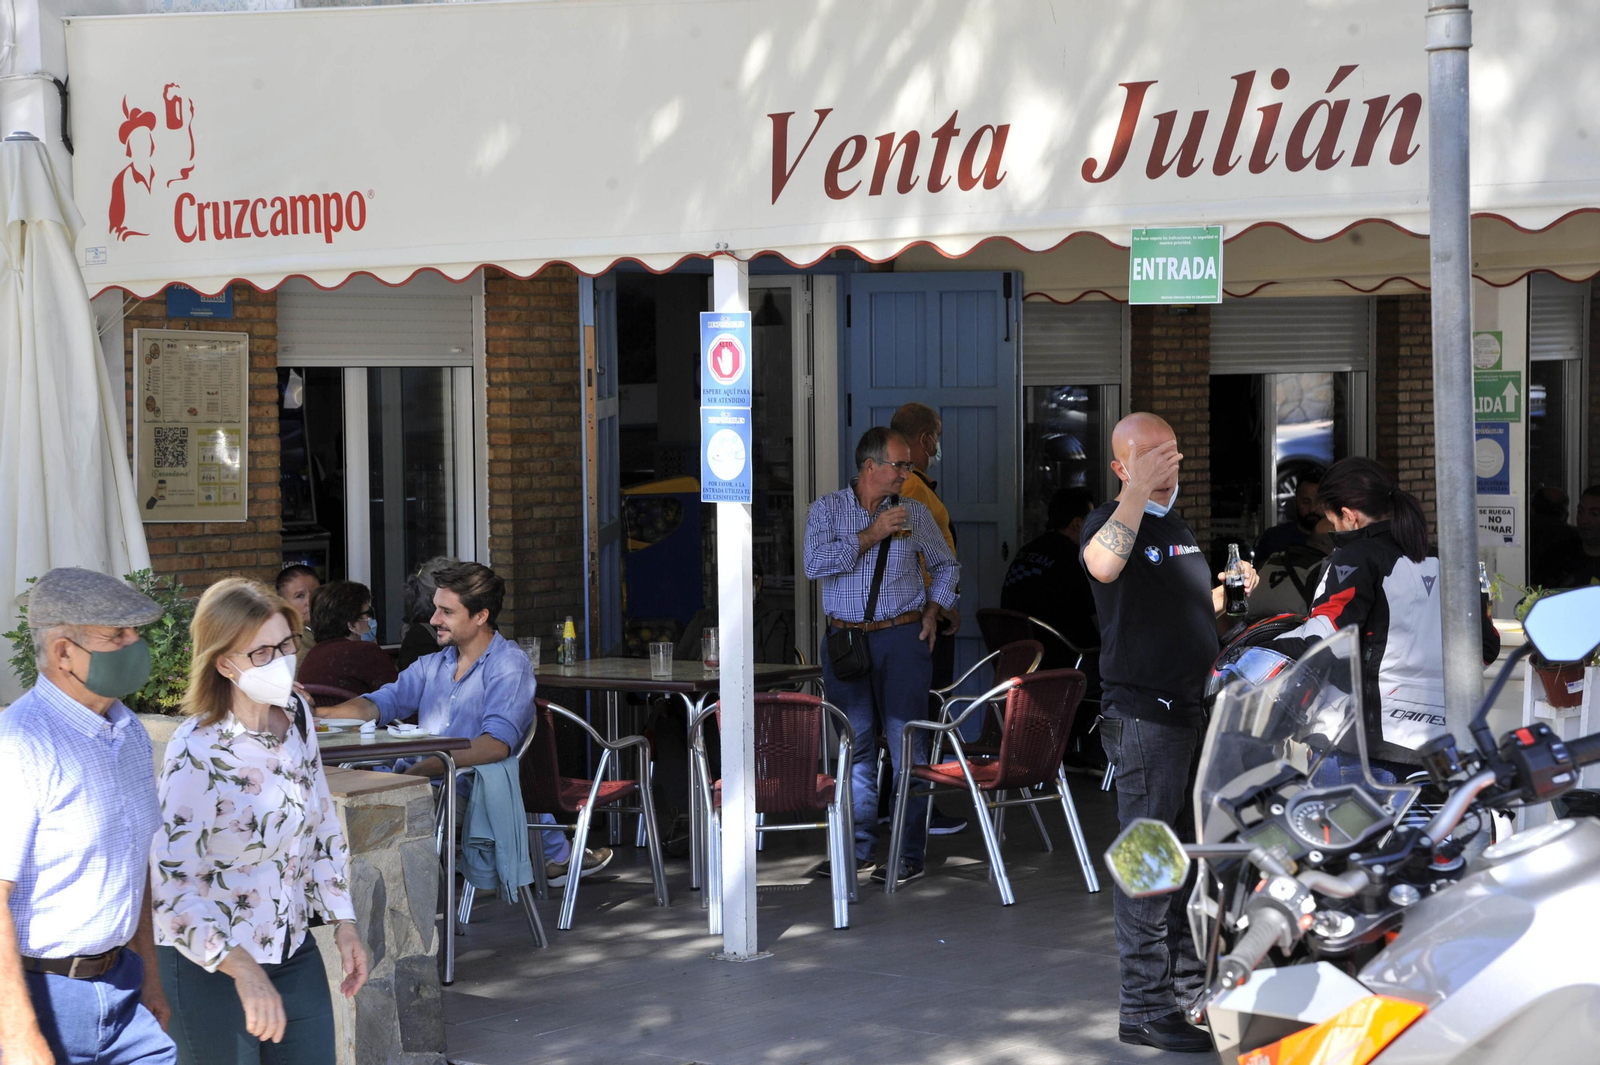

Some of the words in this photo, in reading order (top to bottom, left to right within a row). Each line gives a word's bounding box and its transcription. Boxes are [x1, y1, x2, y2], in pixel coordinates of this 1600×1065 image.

[767, 107, 1011, 205] Venta
[1081, 64, 1423, 183] Julián
[173, 190, 367, 244] Cruzcampo
[1133, 256, 1217, 280] ENTRADA
[723, 387, 736, 396] AQUÍ
[1474, 397, 1503, 413] LIDA
[1025, 552, 1055, 569] TEAM
[1389, 709, 1446, 726] DAINES
